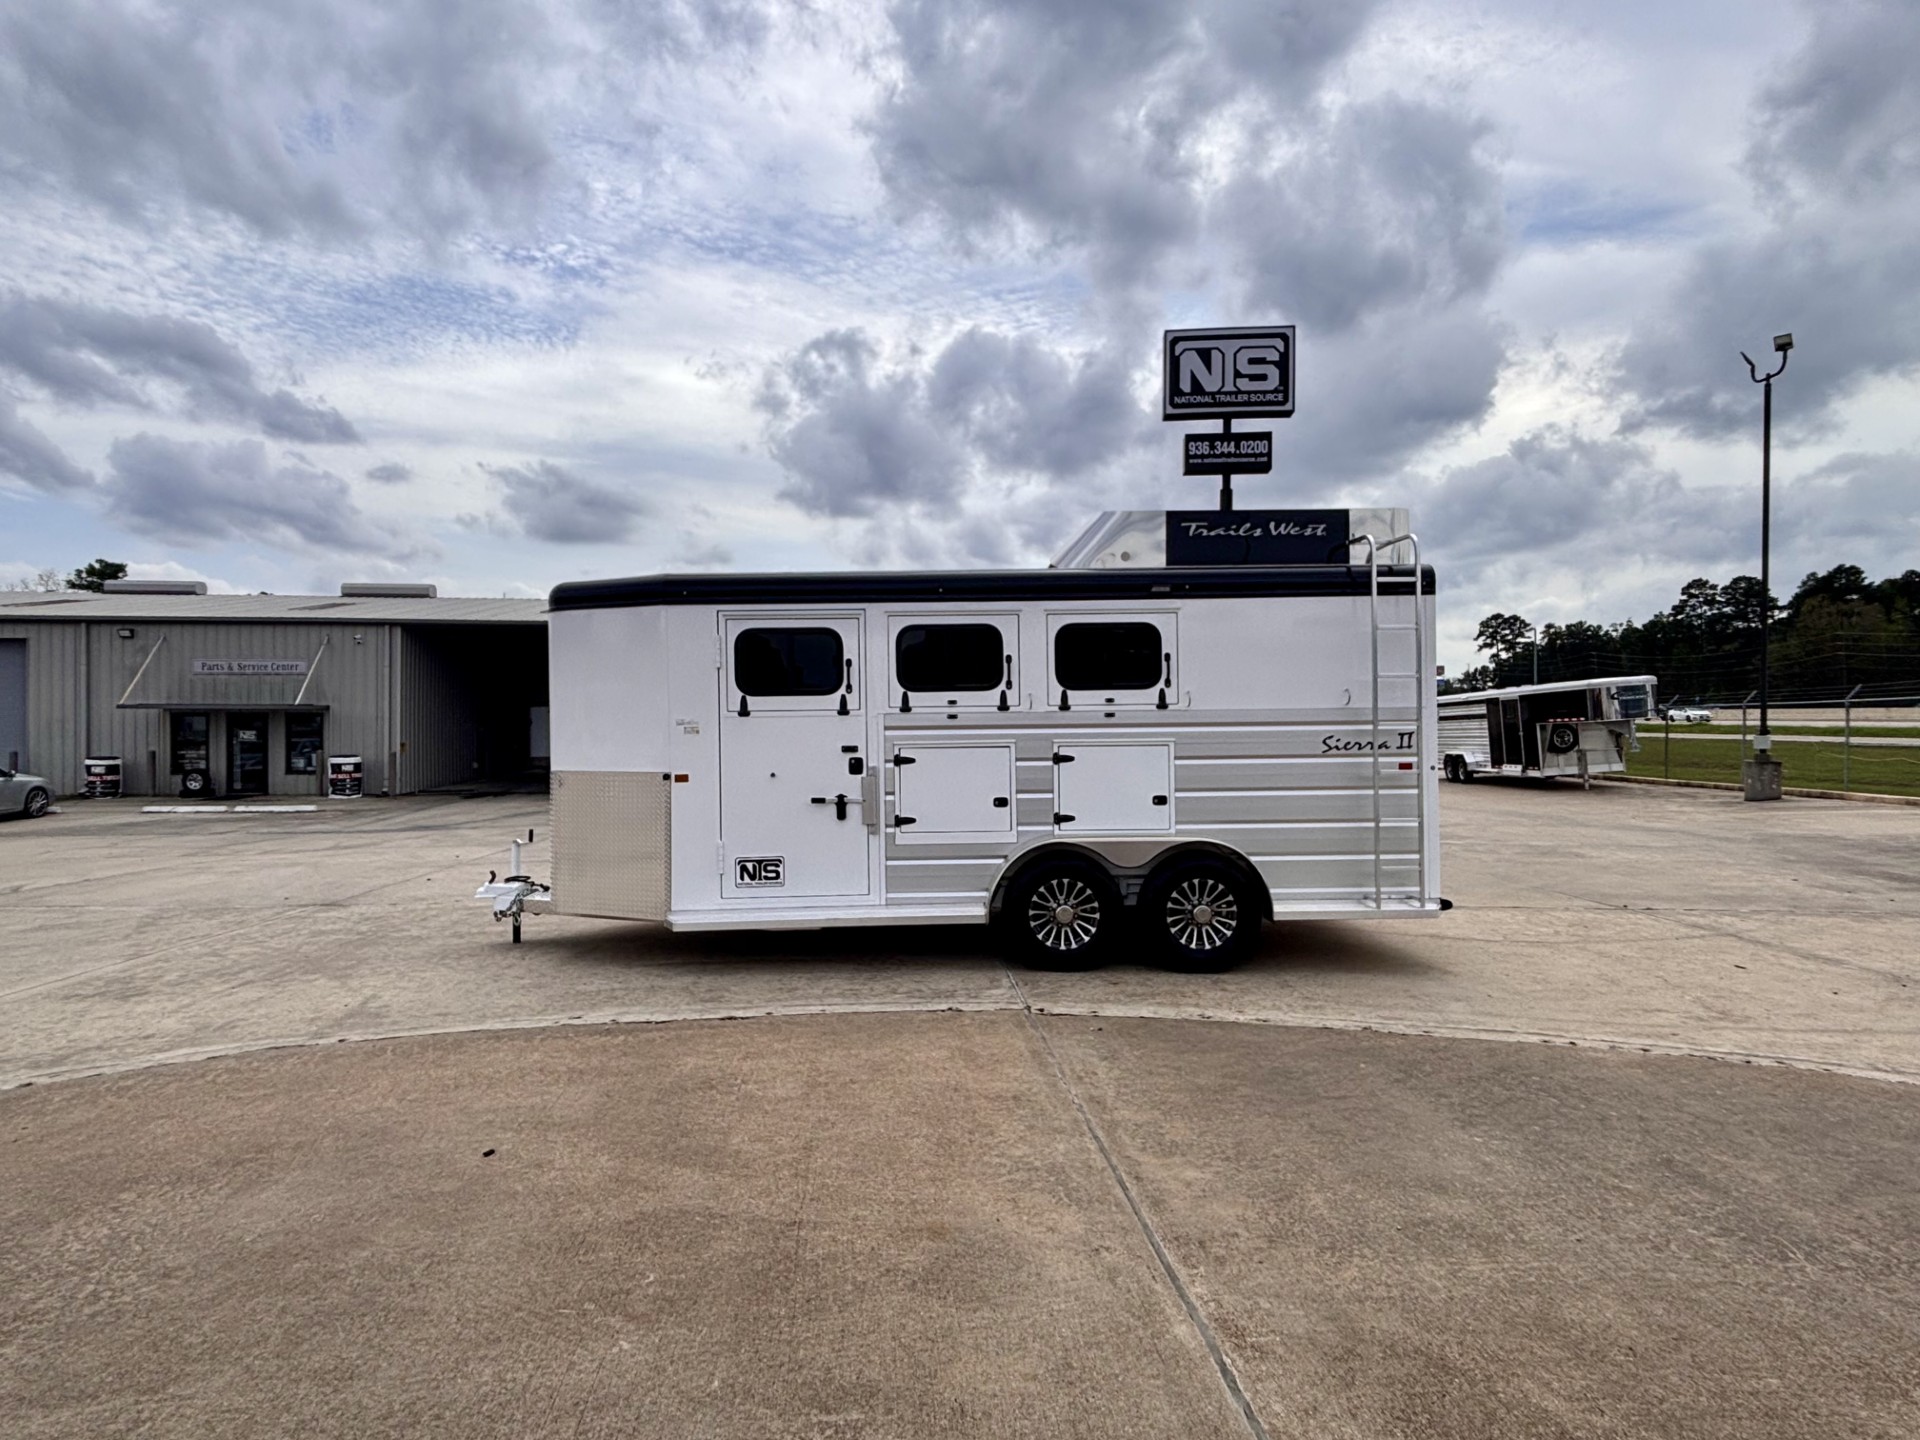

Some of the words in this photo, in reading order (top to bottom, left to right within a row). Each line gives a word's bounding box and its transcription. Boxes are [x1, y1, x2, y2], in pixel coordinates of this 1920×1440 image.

[1174, 337, 1285, 393] NTS
[1174, 395, 1215, 404] NATIONAL
[1215, 394, 1249, 403] TRAILER
[1249, 393, 1284, 402] SOURCE
[1188, 440, 1269, 455] 936.344.0200
[1180, 521, 1264, 537] Trails
[1268, 520, 1327, 536] West
[201, 662, 225, 672] Parts
[227, 662, 235, 672] &
[237, 662, 269, 672] Service
[271, 662, 300, 672] Center
[1321, 734, 1391, 754] Sierra
[1395, 731, 1415, 750] II
[737, 858, 783, 881] NTS
